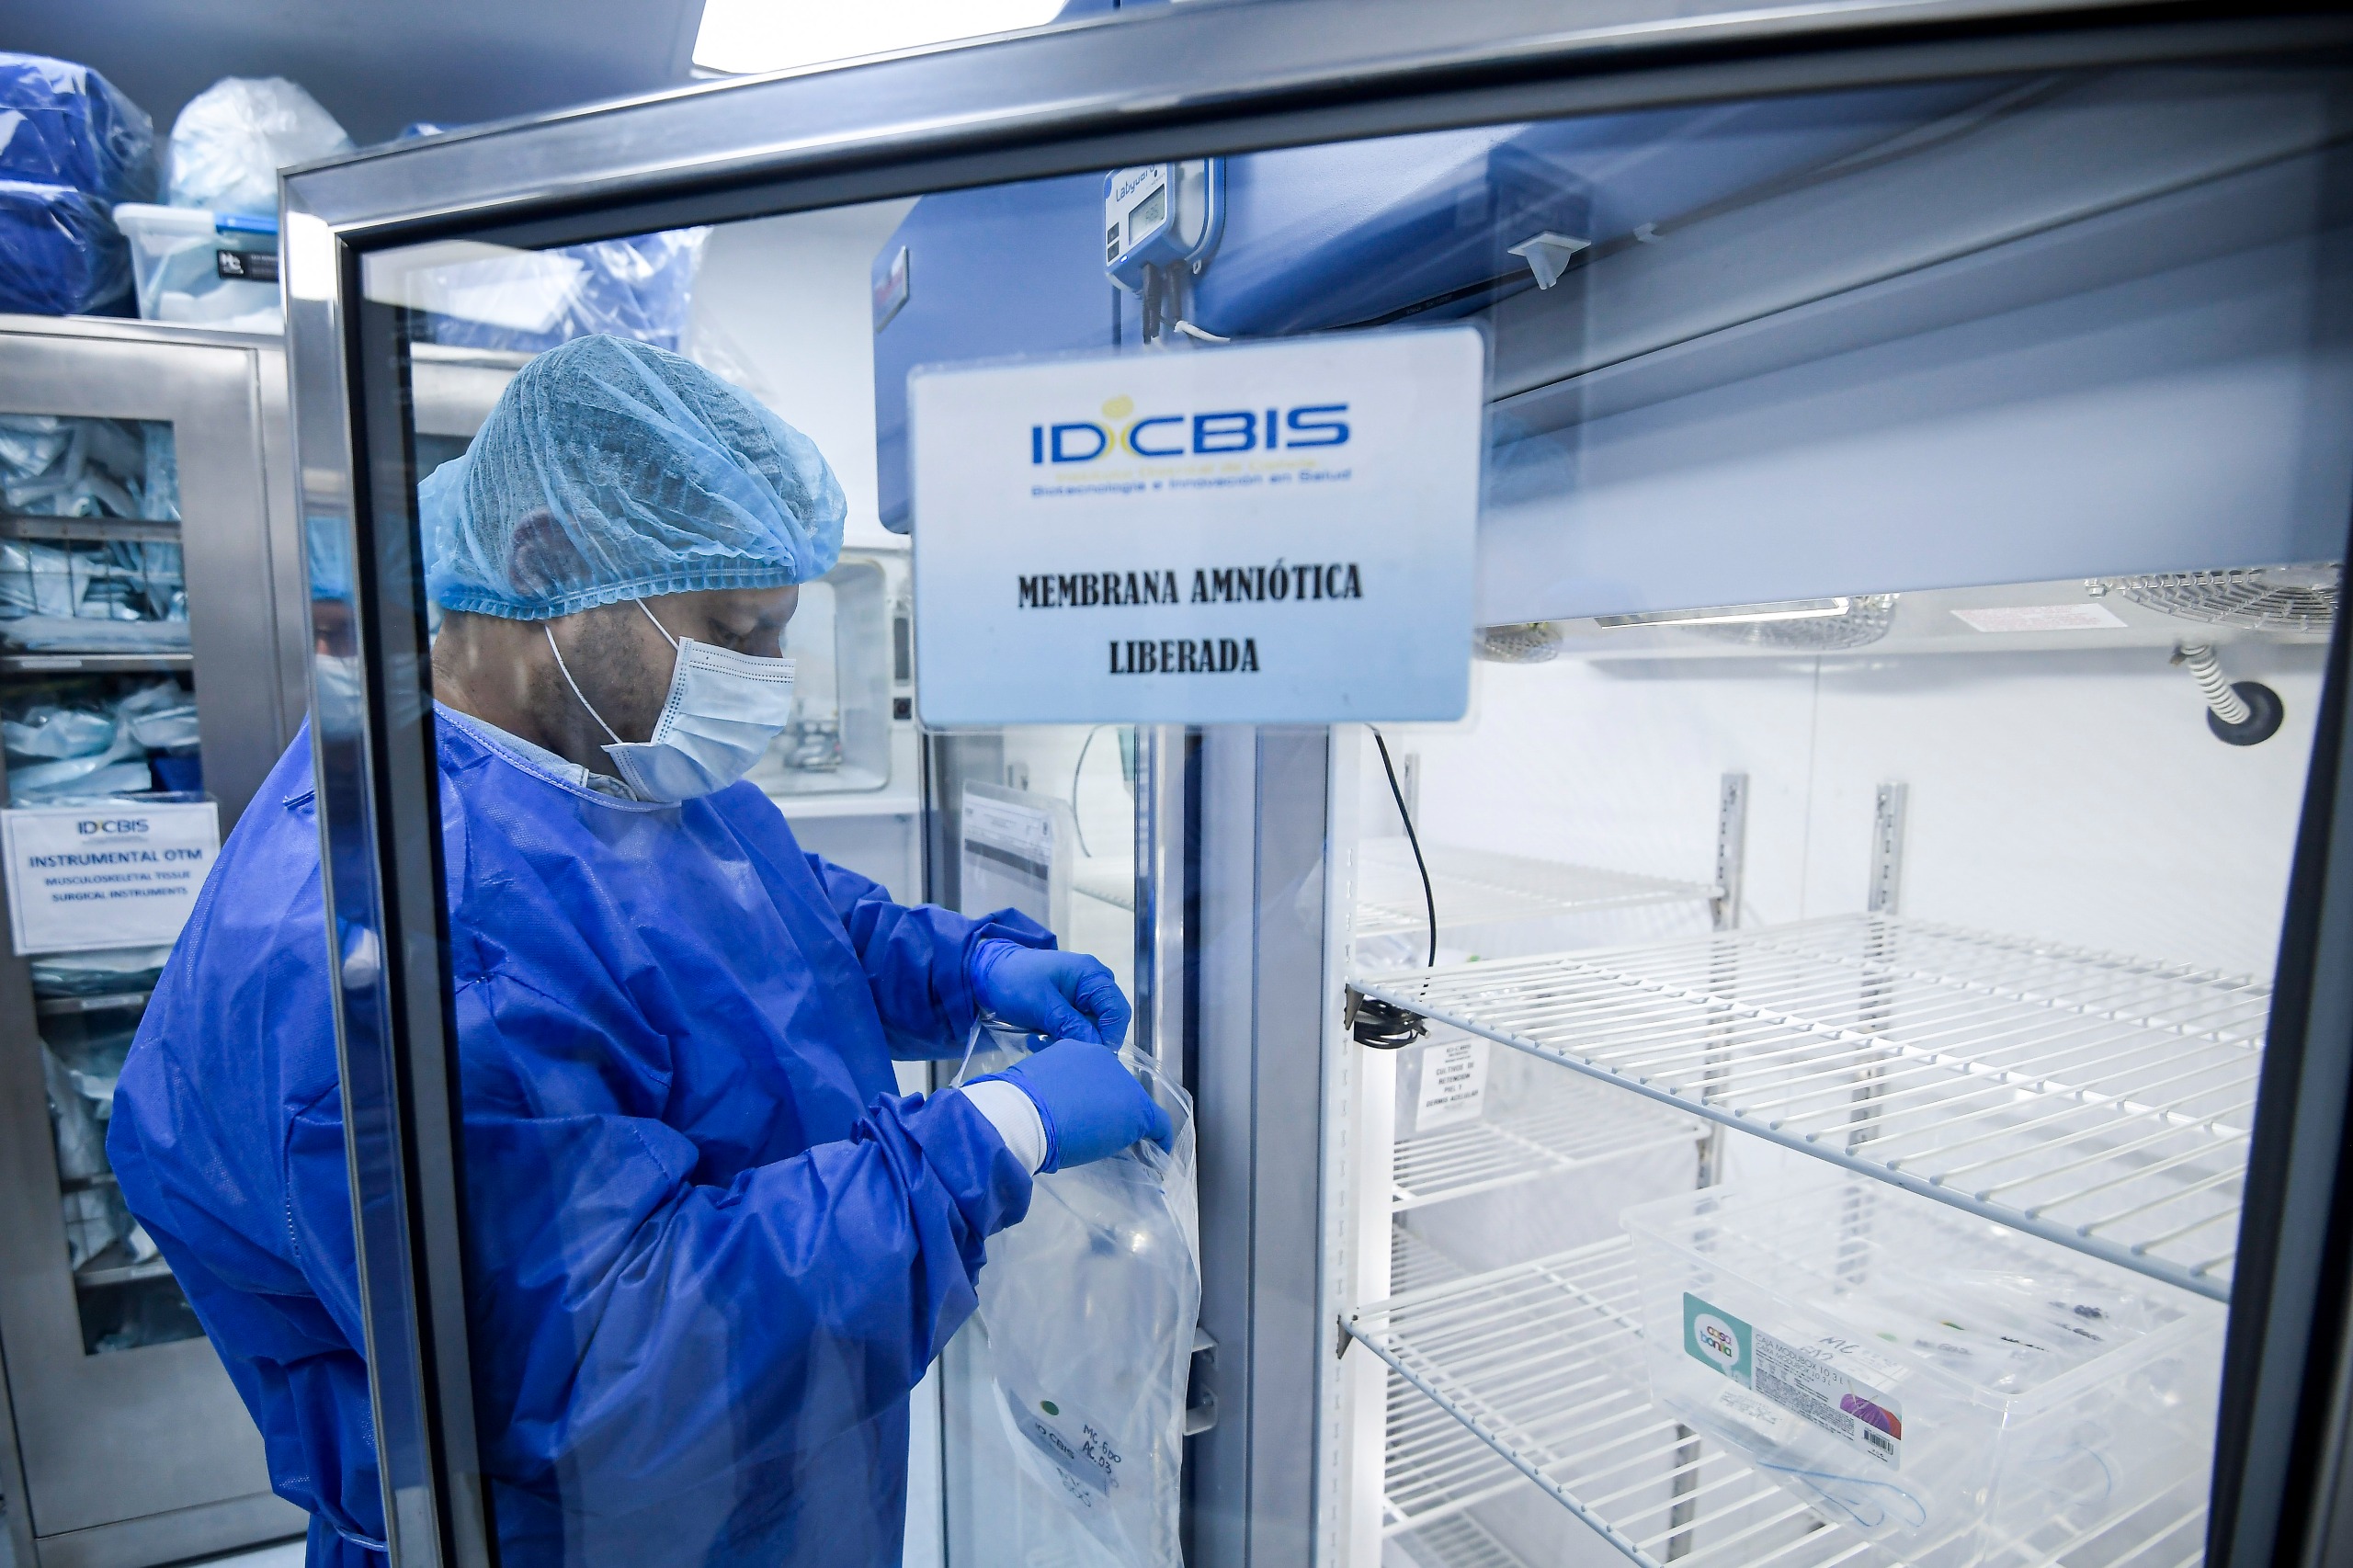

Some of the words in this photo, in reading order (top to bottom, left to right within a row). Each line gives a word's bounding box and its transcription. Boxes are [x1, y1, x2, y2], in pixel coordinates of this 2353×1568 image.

[1017, 569, 1180, 608] MEMBRANA
[1190, 557, 1364, 604] AMNIÓTICA
[1108, 638, 1260, 675] LIBERADA
[29, 850, 159, 869] INSTRUMENTAL
[165, 848, 203, 861] OTM
[45, 873, 152, 887] MUSCULOSKELETAL
[156, 871, 190, 881] TISSUE
[52, 890, 106, 902] SURGICAL
[110, 887, 188, 899] INSTRUMENTS
[1437, 1063, 1463, 1075] CULTIVOS
[1699, 1330, 1733, 1358] bonita
[1707, 1325, 1732, 1346] casa
[1776, 1344, 1816, 1370] MODUBOX
